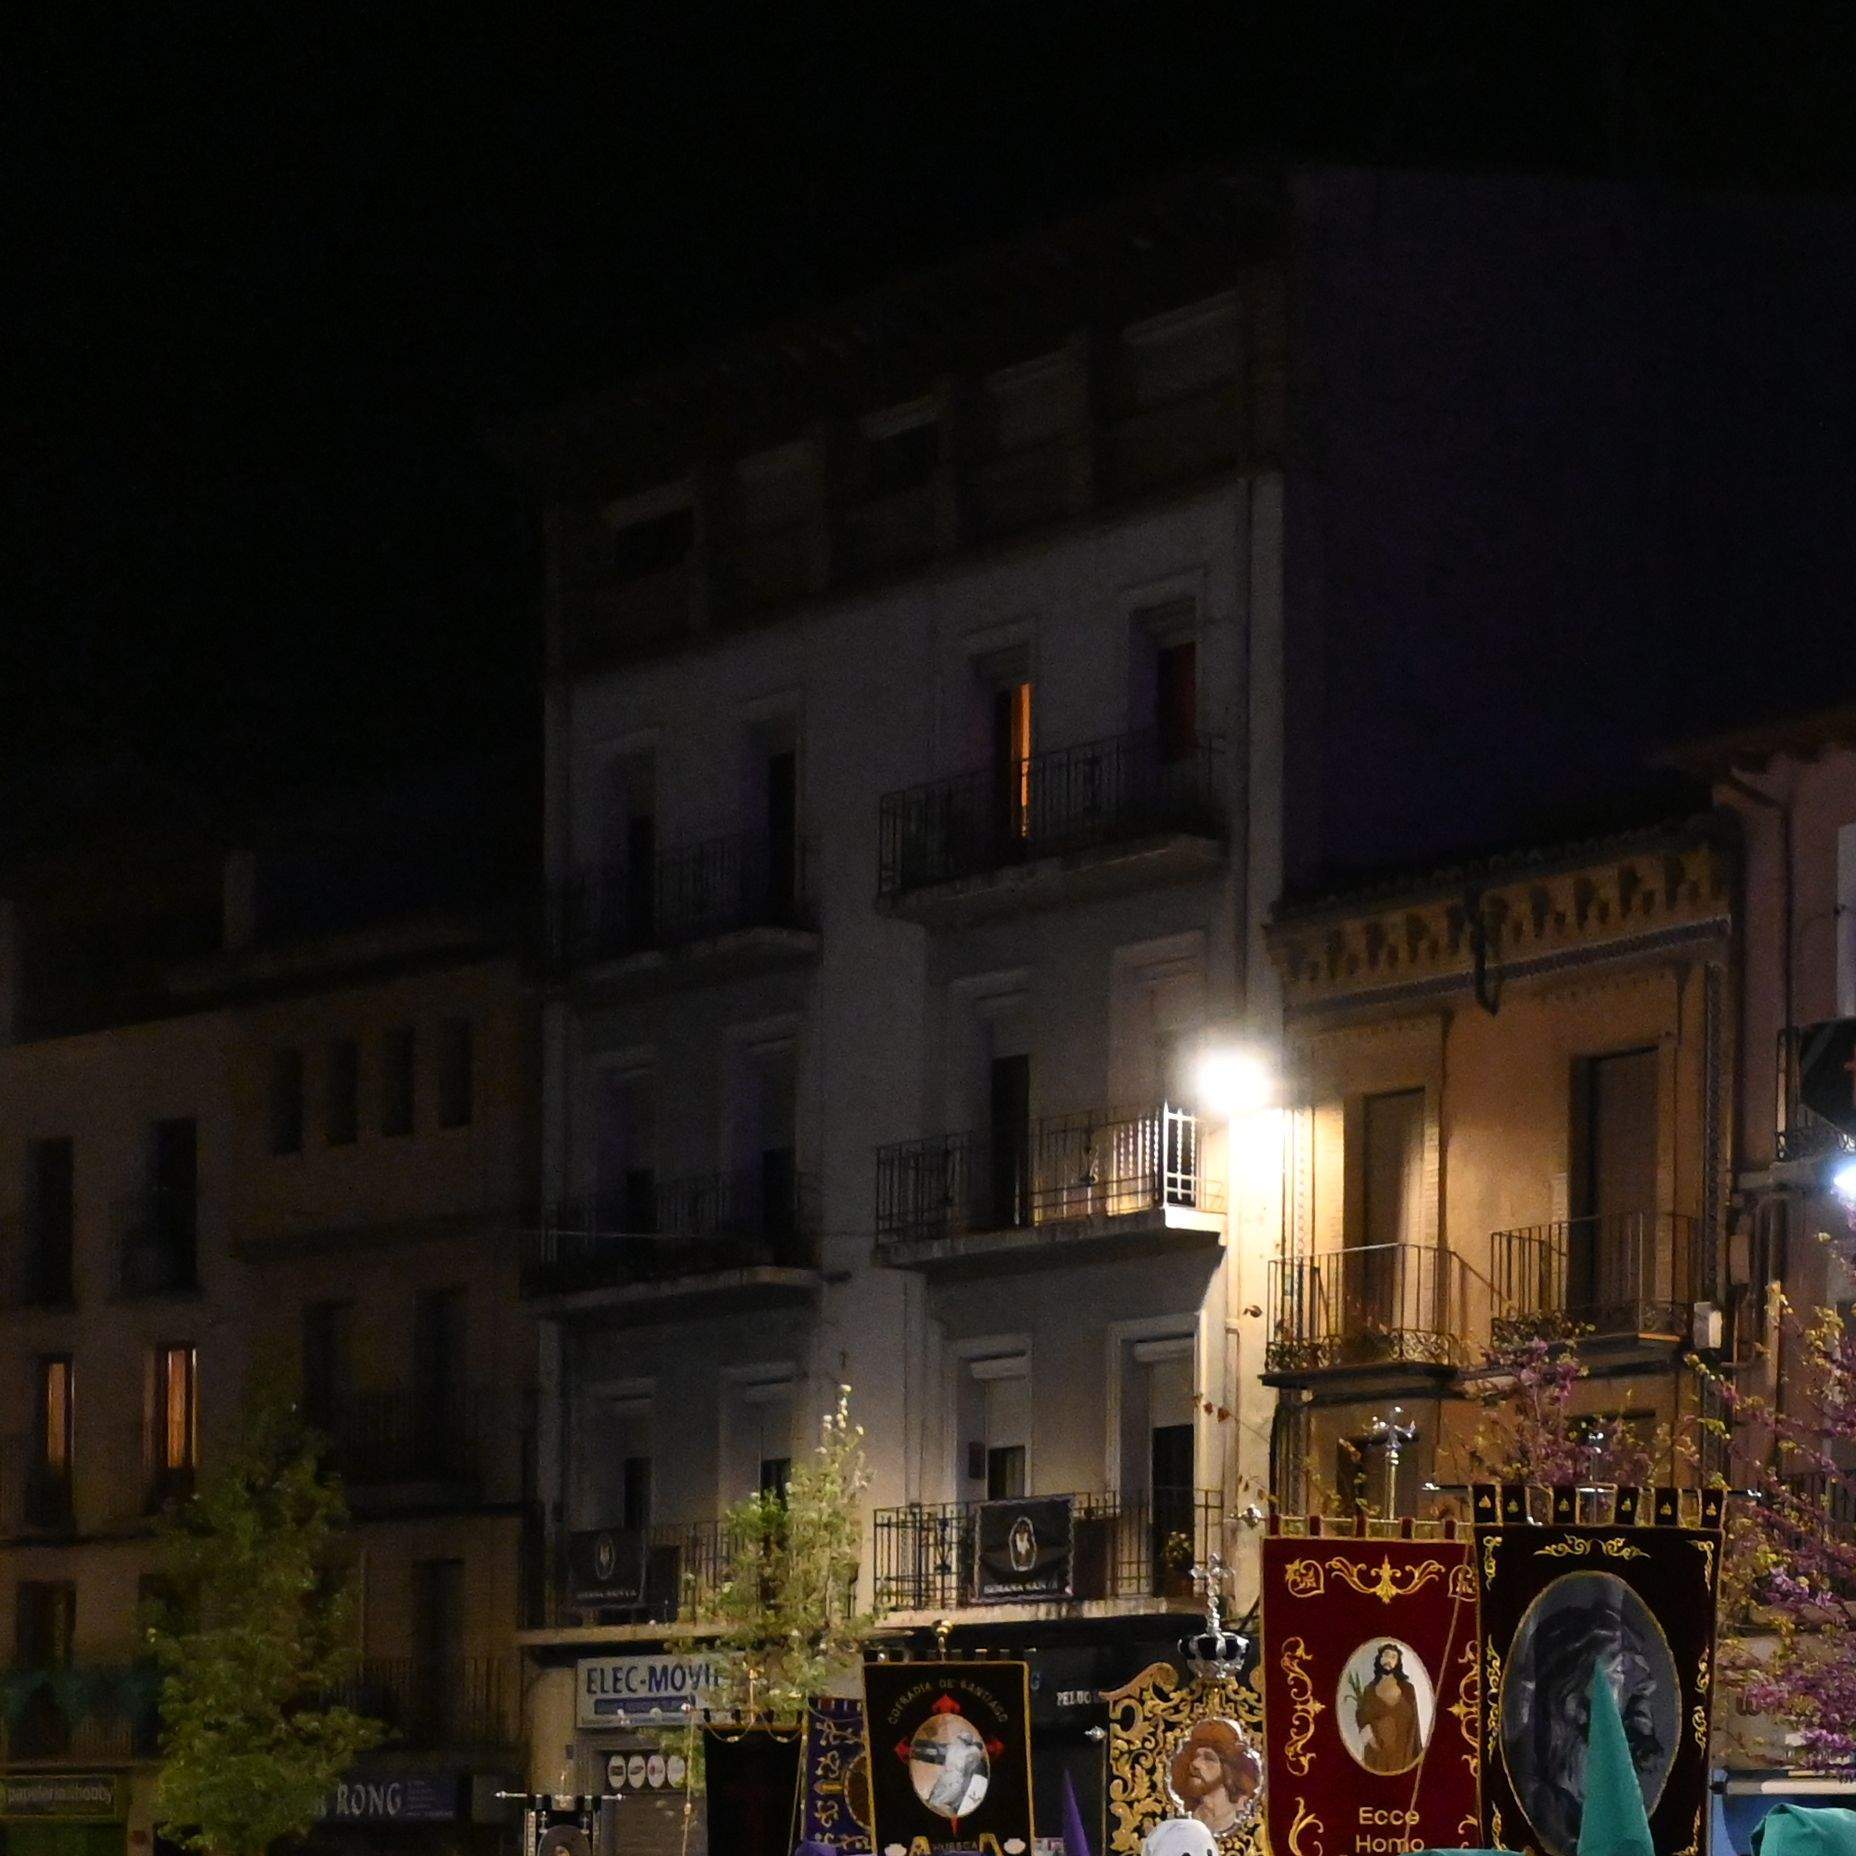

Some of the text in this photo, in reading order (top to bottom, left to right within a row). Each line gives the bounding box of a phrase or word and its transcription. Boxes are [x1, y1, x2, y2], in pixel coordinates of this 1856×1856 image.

[336, 1782, 401, 1817] RONG
[1359, 1806, 1419, 1825] Ecce
[1355, 1833, 1425, 1853] Homo
